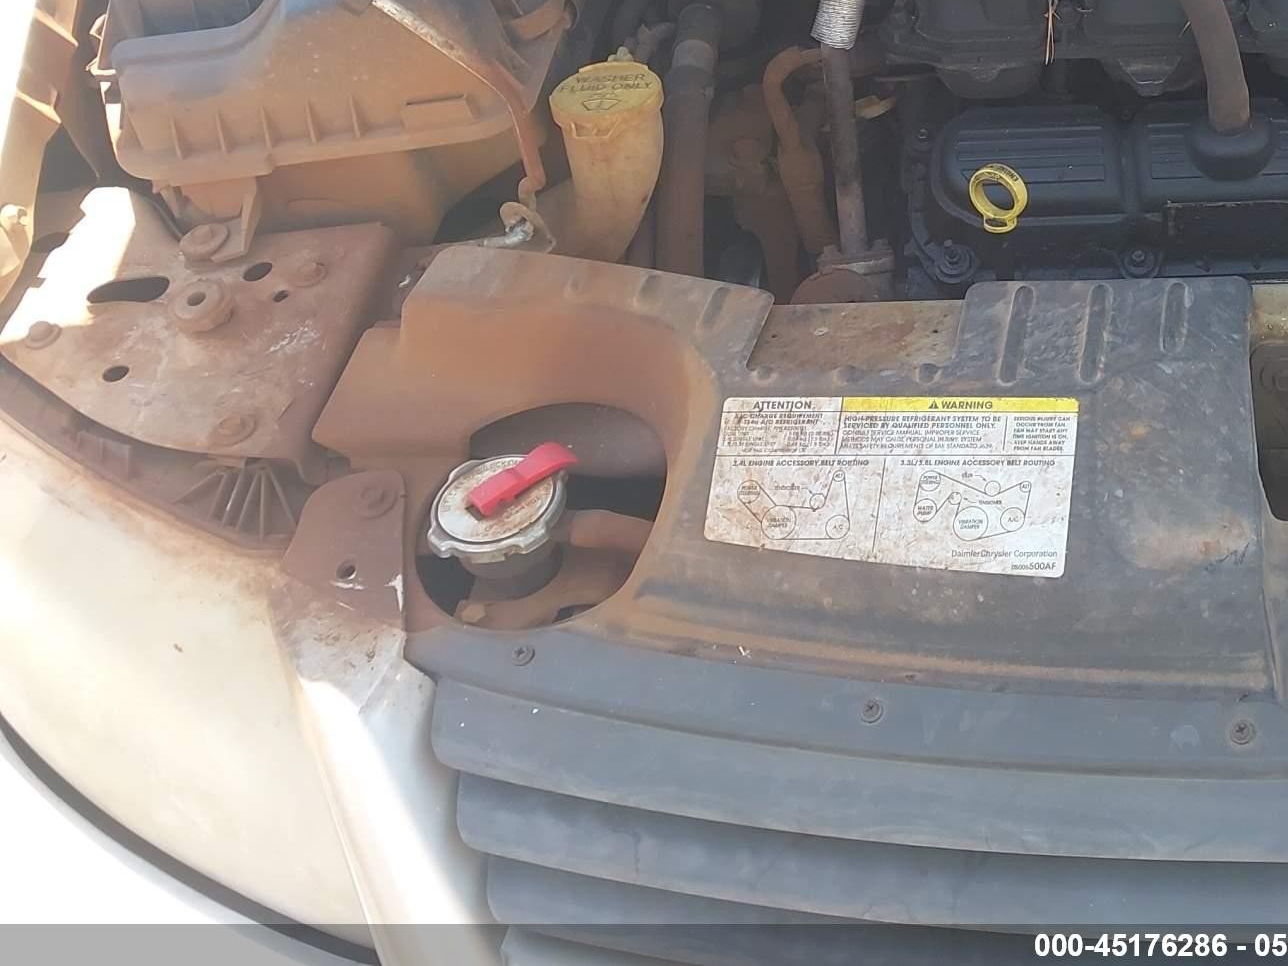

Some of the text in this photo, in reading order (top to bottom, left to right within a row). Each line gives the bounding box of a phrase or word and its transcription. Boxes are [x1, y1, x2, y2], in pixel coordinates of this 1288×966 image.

[576, 73, 646, 83] WASHER
[561, 82, 652, 92] FLUID ONLY
[753, 400, 812, 411] ATTENTION
[941, 400, 993, 410] WARNING
[951, 549, 1058, 560] DaimlerChrysler Corporation
